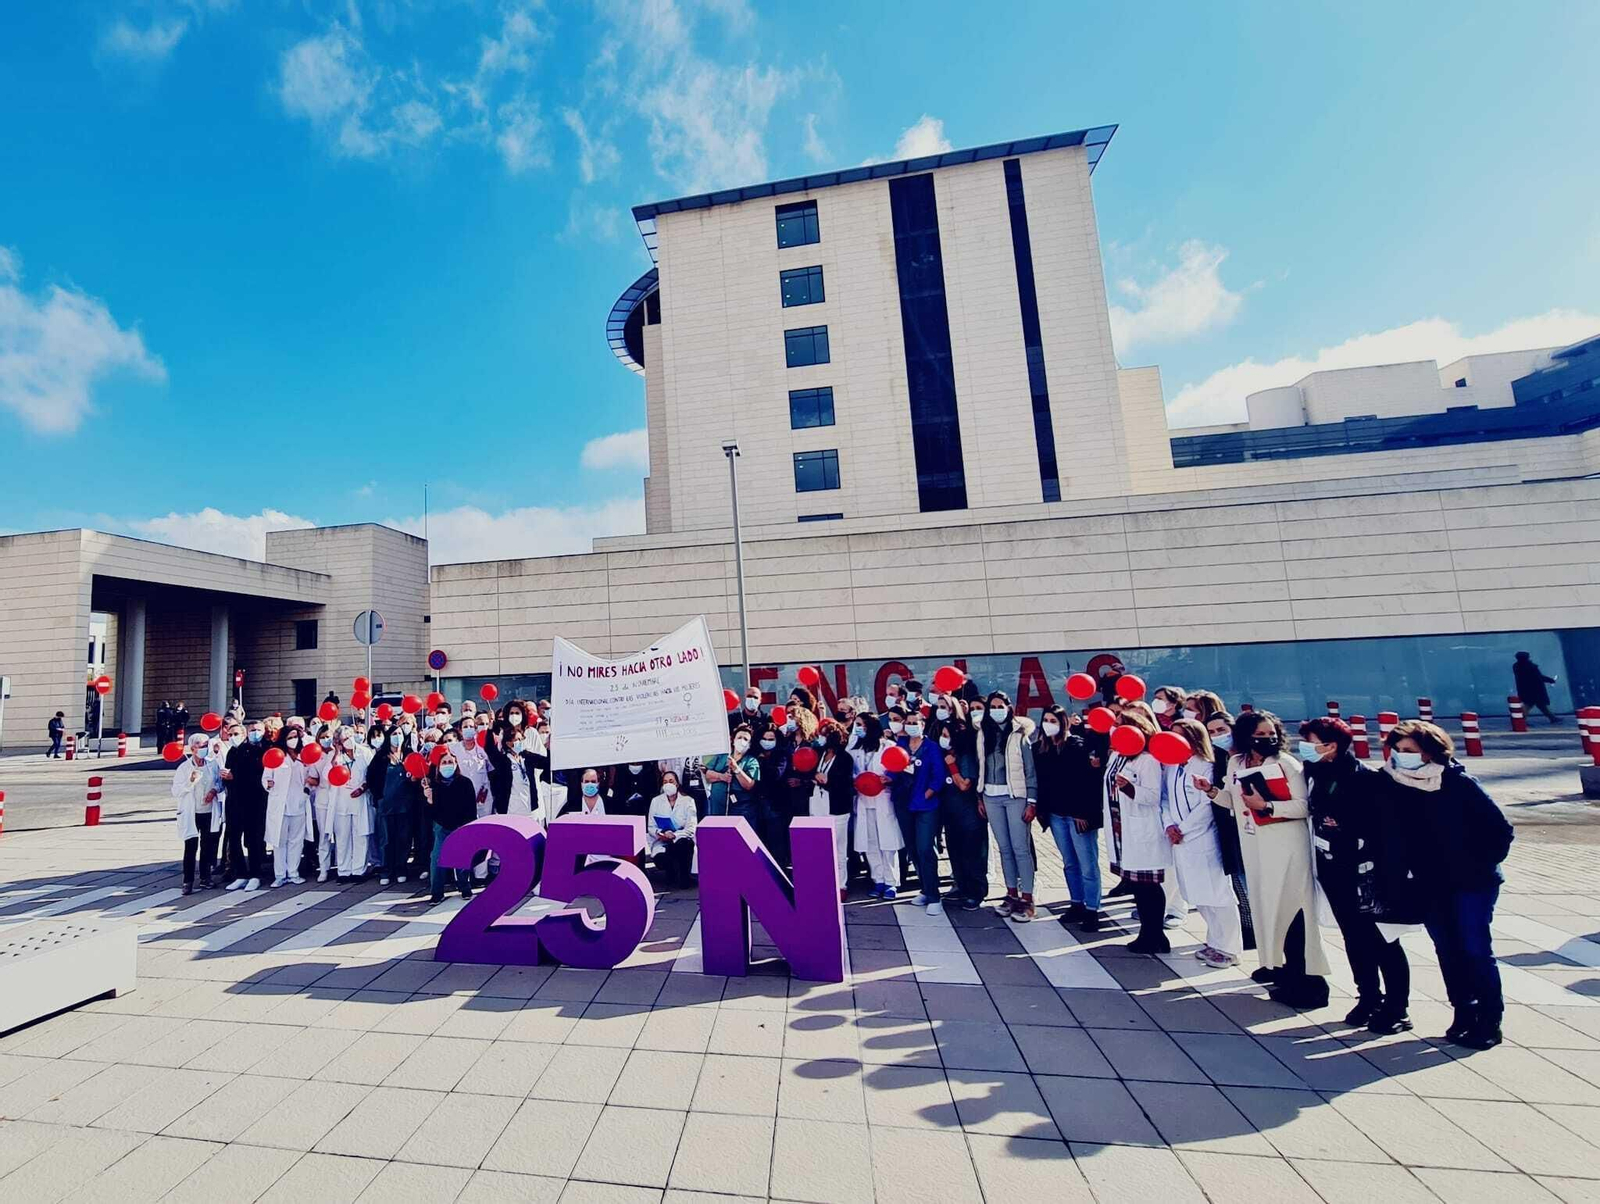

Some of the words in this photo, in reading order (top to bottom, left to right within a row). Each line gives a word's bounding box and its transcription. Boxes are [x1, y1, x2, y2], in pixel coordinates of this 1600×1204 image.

[587, 665, 617, 679] MIRES
[622, 659, 647, 676] HACIA
[650, 654, 673, 671] OTRO
